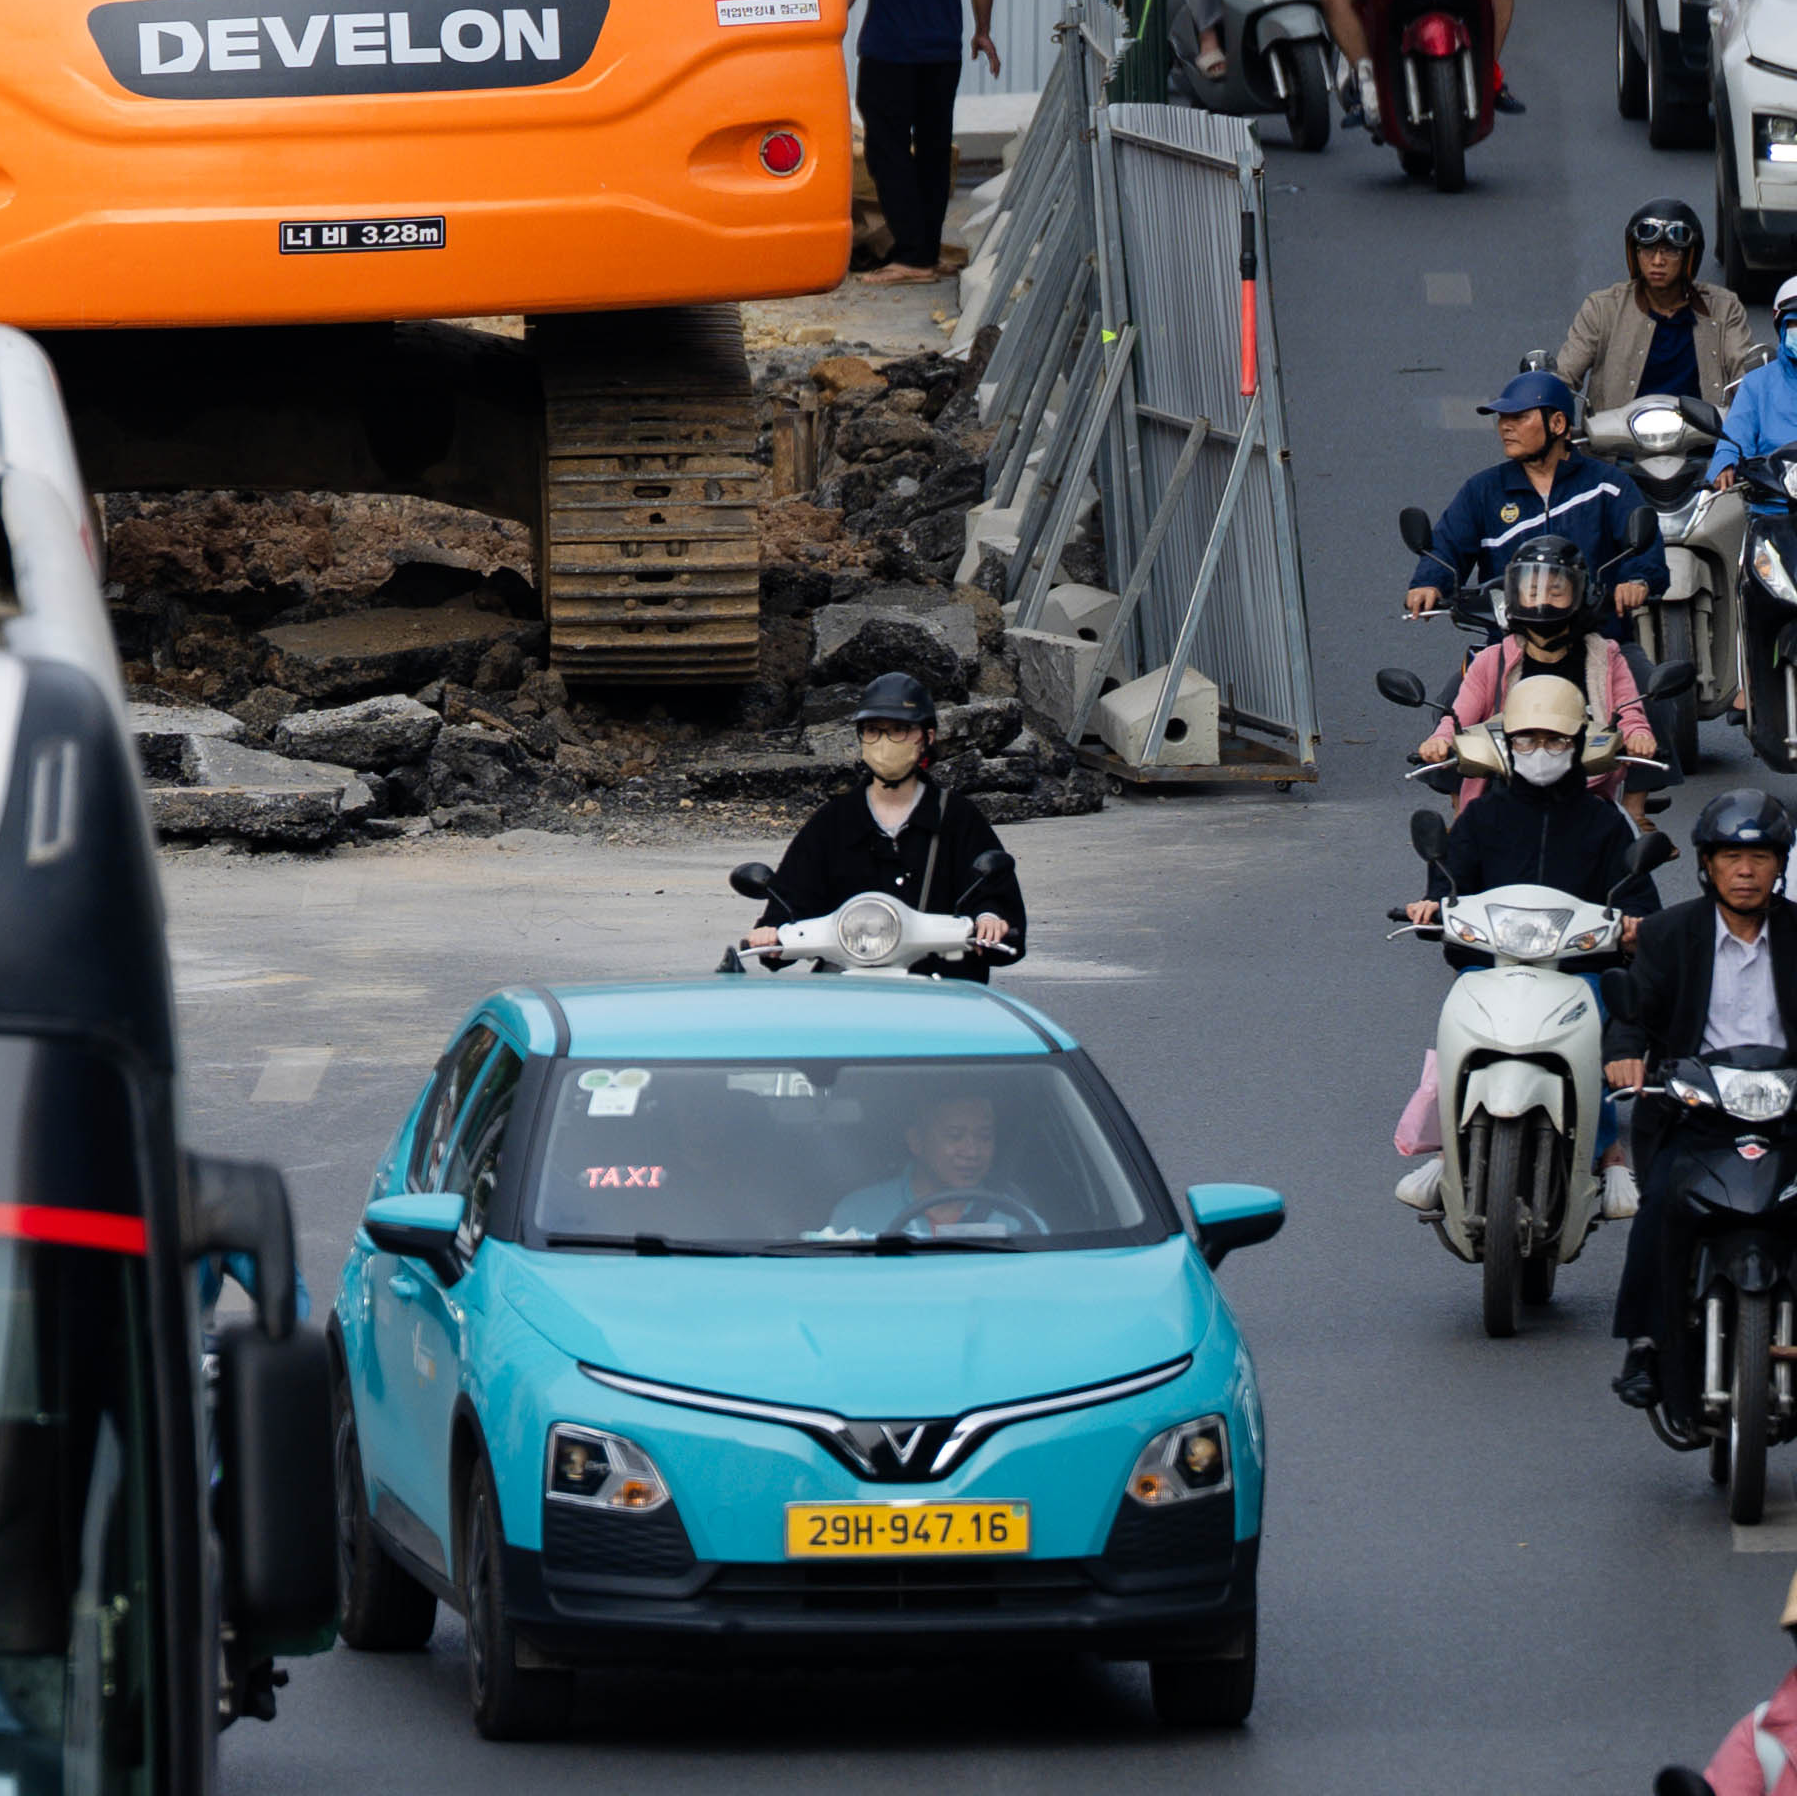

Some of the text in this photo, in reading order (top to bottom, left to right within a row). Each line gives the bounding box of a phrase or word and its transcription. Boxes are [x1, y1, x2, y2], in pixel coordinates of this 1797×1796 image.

[140, 7, 561, 76] DEVELON
[360, 220, 439, 246] 3.28m
[586, 1165, 663, 1188] TAXI
[809, 1512, 1008, 1548] 29H-947.16
